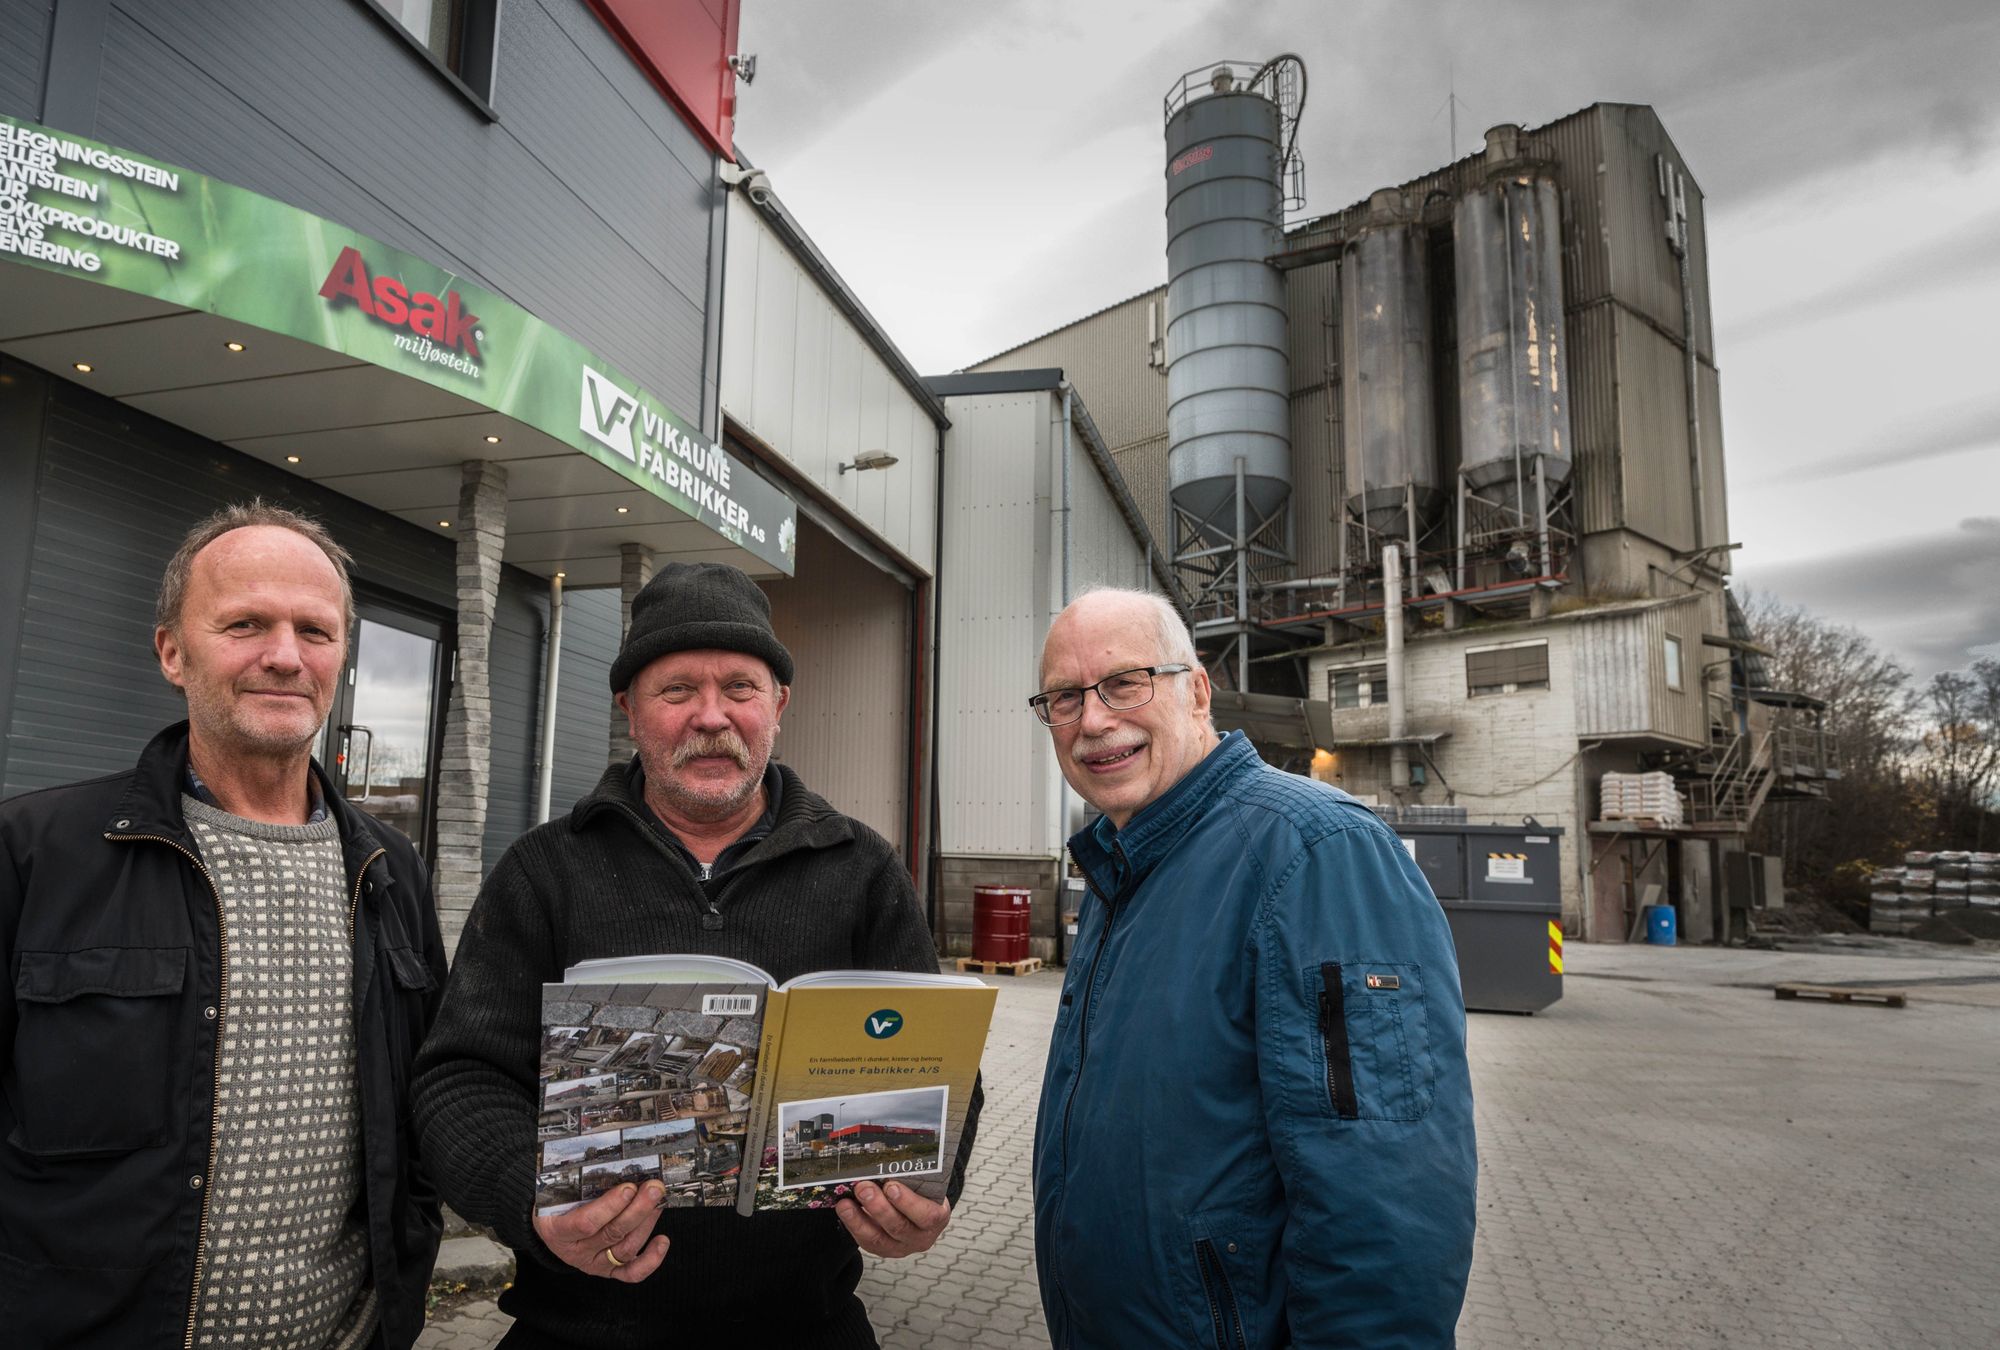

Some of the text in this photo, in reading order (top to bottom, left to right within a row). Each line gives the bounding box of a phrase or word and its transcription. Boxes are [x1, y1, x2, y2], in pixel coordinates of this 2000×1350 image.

[0, 122, 179, 191] ELEGNINGSSTEIN
[0, 196, 180, 260] OKKPRODUKTER
[0, 231, 101, 272] ENERING
[319, 246, 480, 358] Asak
[394, 332, 479, 378] miljøstein
[642, 405, 731, 490] VIKAUNE
[639, 441, 766, 543] FABRIKKER AS
[809, 1066, 940, 1075] Vikaune Fabrikker A/S
[877, 1158, 936, 1175] 100år
